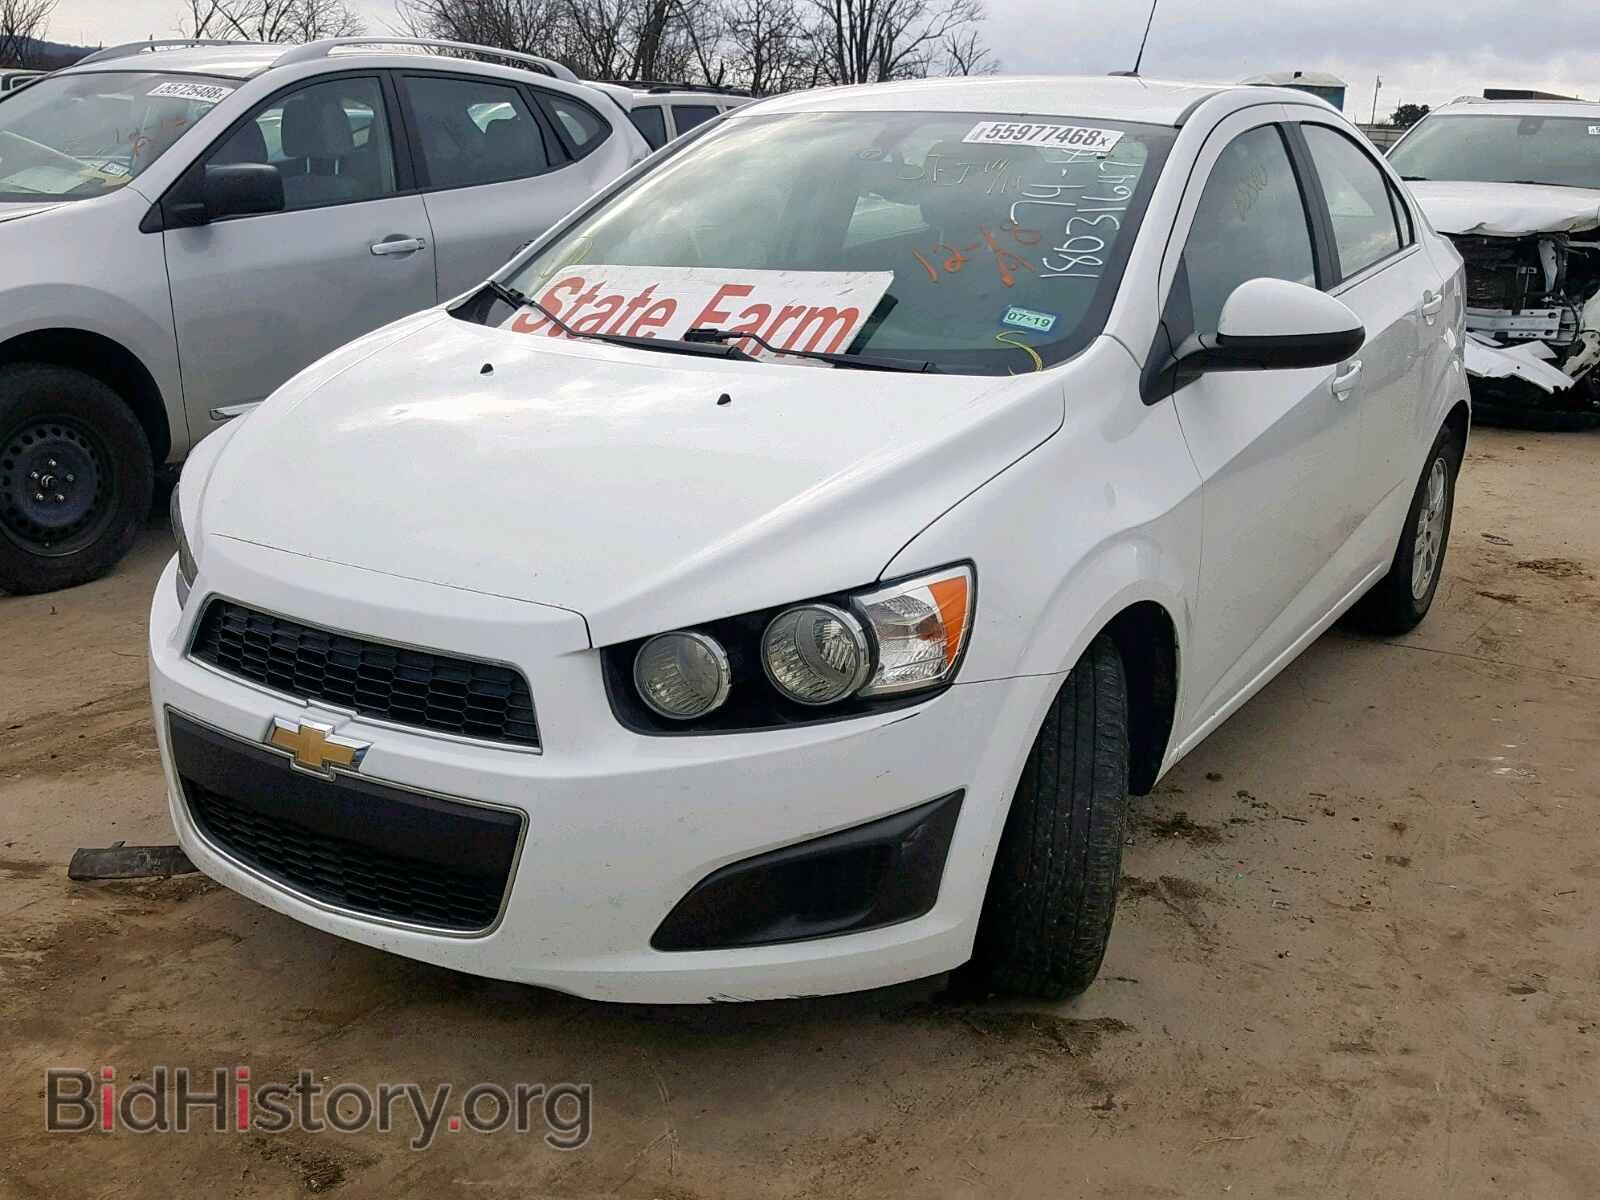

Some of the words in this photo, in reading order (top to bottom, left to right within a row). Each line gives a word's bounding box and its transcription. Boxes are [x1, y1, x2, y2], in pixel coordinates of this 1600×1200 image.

[511, 276, 678, 341] State
[680, 284, 860, 358] Farm
[1007, 312, 1051, 328] 07-19
